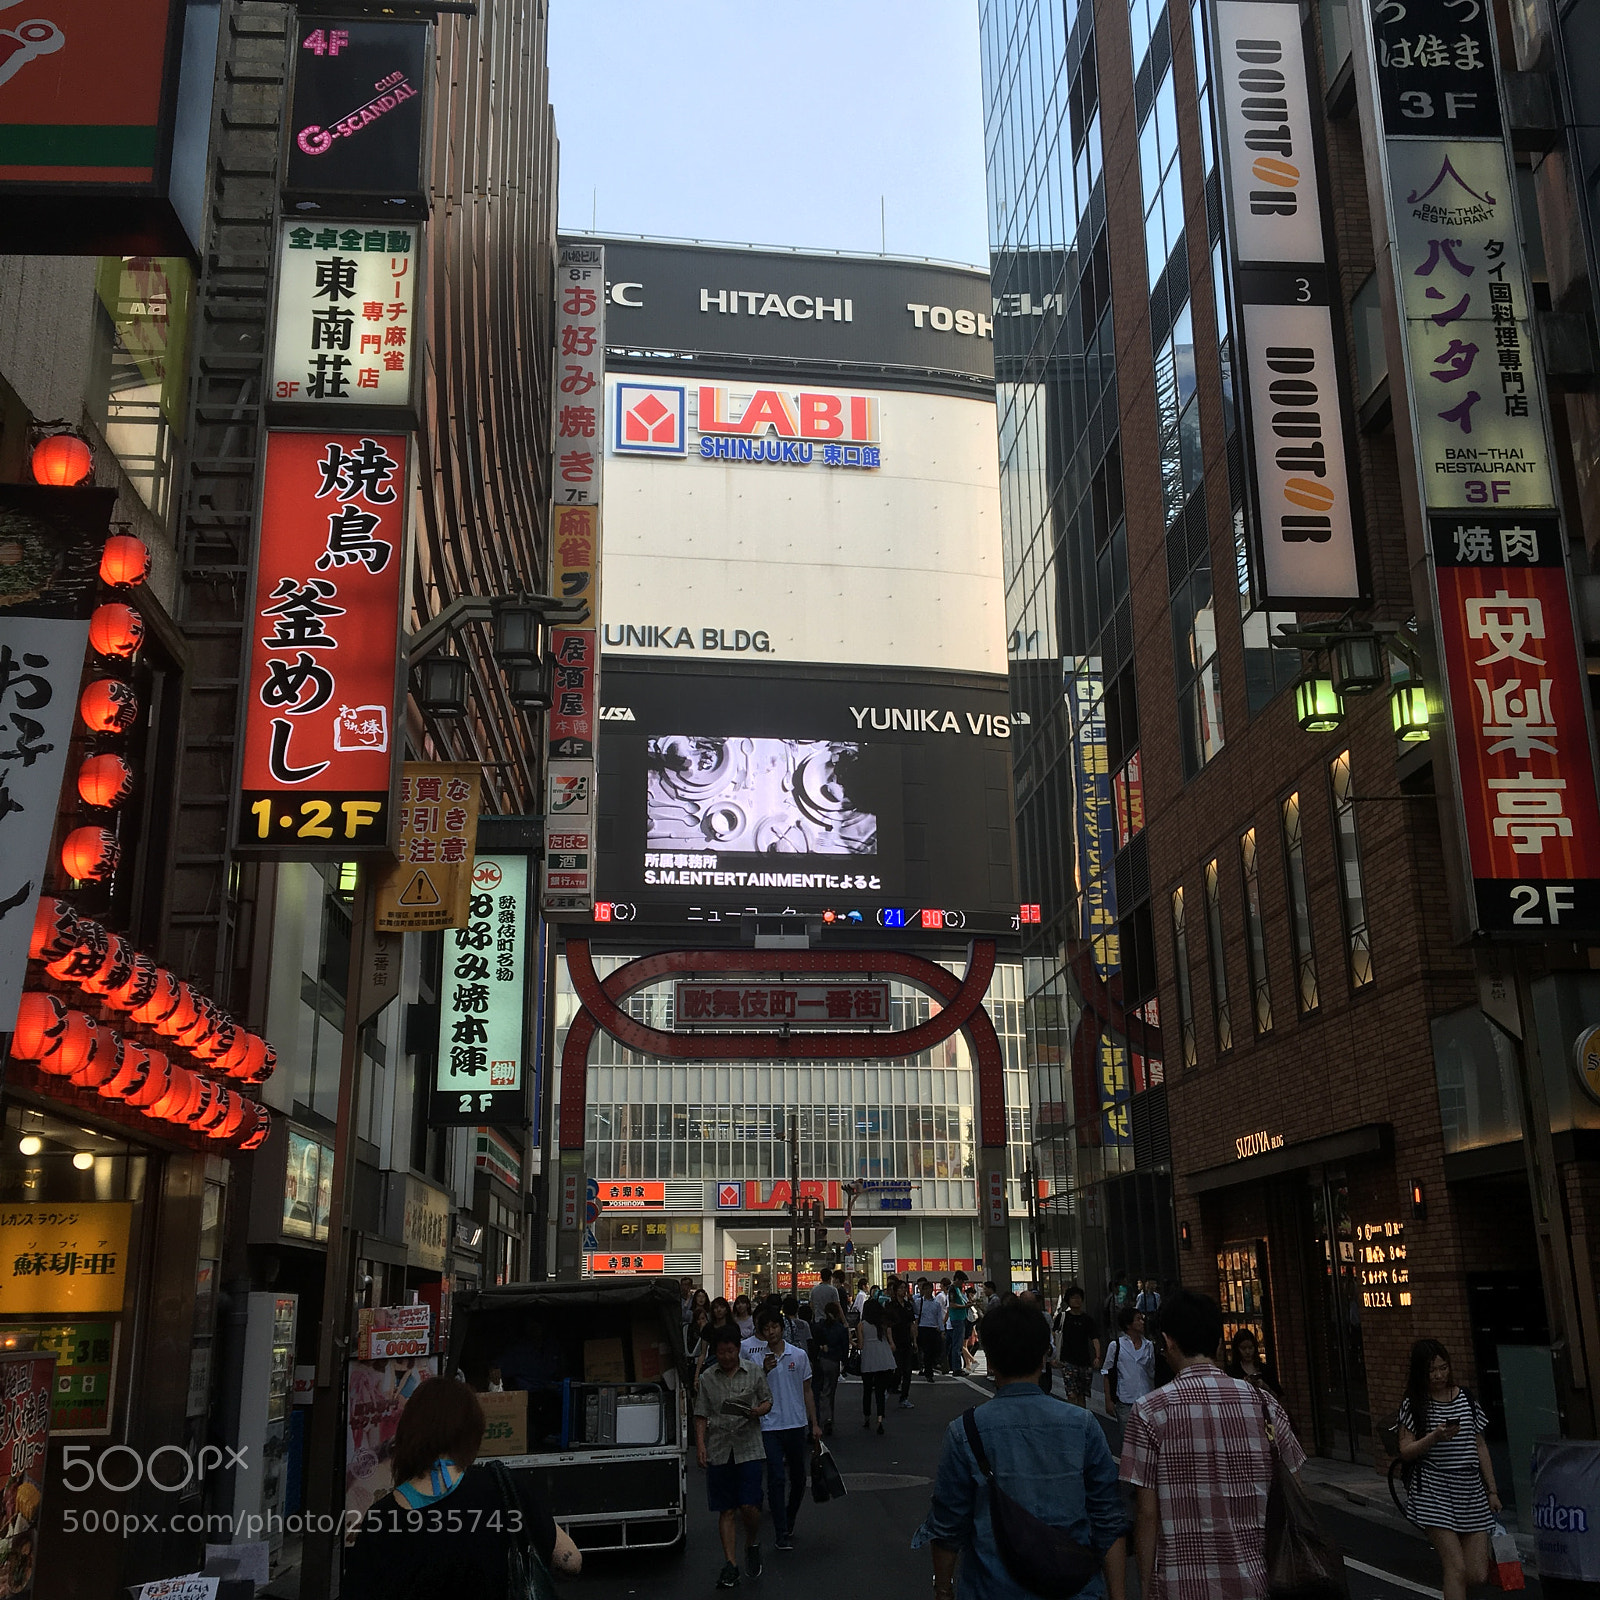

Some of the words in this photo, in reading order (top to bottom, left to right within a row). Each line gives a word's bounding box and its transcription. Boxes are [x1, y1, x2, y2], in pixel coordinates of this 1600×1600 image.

[303, 29, 349, 55] 4F
[375, 71, 404, 91] CLUB
[1400, 91, 1478, 118] 3F
[298, 84, 418, 155] G-SCANDAL
[1236, 39, 1300, 216] DOUTOR
[1412, 208, 1494, 226] RESTAURANT
[1422, 203, 1484, 216] BAN-THAI
[289, 227, 411, 253] 全卓全自動
[562, 250, 599, 263] 小松ビル
[569, 269, 591, 281] 8F
[1295, 277, 1311, 302] 3
[383, 257, 409, 371] リーチ麻雀
[700, 288, 853, 322] HITACHI
[306, 256, 359, 398] 東南荘
[1414, 239, 1481, 434] バンタイ
[1483, 239, 1529, 418] タイ国料理専門店
[357, 301, 384, 389] 専門店
[276, 381, 300, 398] 3F
[558, 286, 597, 483] お好み焼き
[698, 386, 881, 443] LABI
[700, 435, 814, 464] SHINJUKU
[823, 443, 881, 468] 東口館
[1266, 347, 1334, 543] DOUTOR
[1445, 448, 1524, 460] BAN-THAI
[1435, 462, 1536, 473] RESTAURANT
[565, 489, 588, 502] 7F
[1464, 480, 1511, 503] 3F
[315, 438, 398, 574] 焼鳥
[1453, 525, 1540, 562] 焼肉
[702, 627, 776, 653] BLDG.
[260, 577, 347, 784] 釜めし
[557, 636, 588, 717] 居酒屋
[555, 719, 589, 734] 本陣
[850, 706, 961, 734] YUNIKA
[1465, 590, 1574, 854] 安楽亭
[558, 739, 584, 755] 4F
[550, 835, 588, 849] たばこ
[558, 854, 577, 868] 酒
[644, 853, 718, 869] 所属事務所
[1509, 885, 1575, 925] 2F
[496, 896, 517, 982] 歌舞伎町名物
[684, 989, 882, 1018] 歌舞伎町一番街
[459, 1095, 494, 1113] 2F
[1235, 1130, 1270, 1160] SUZUYA
[621, 1224, 639, 1235] 2F
